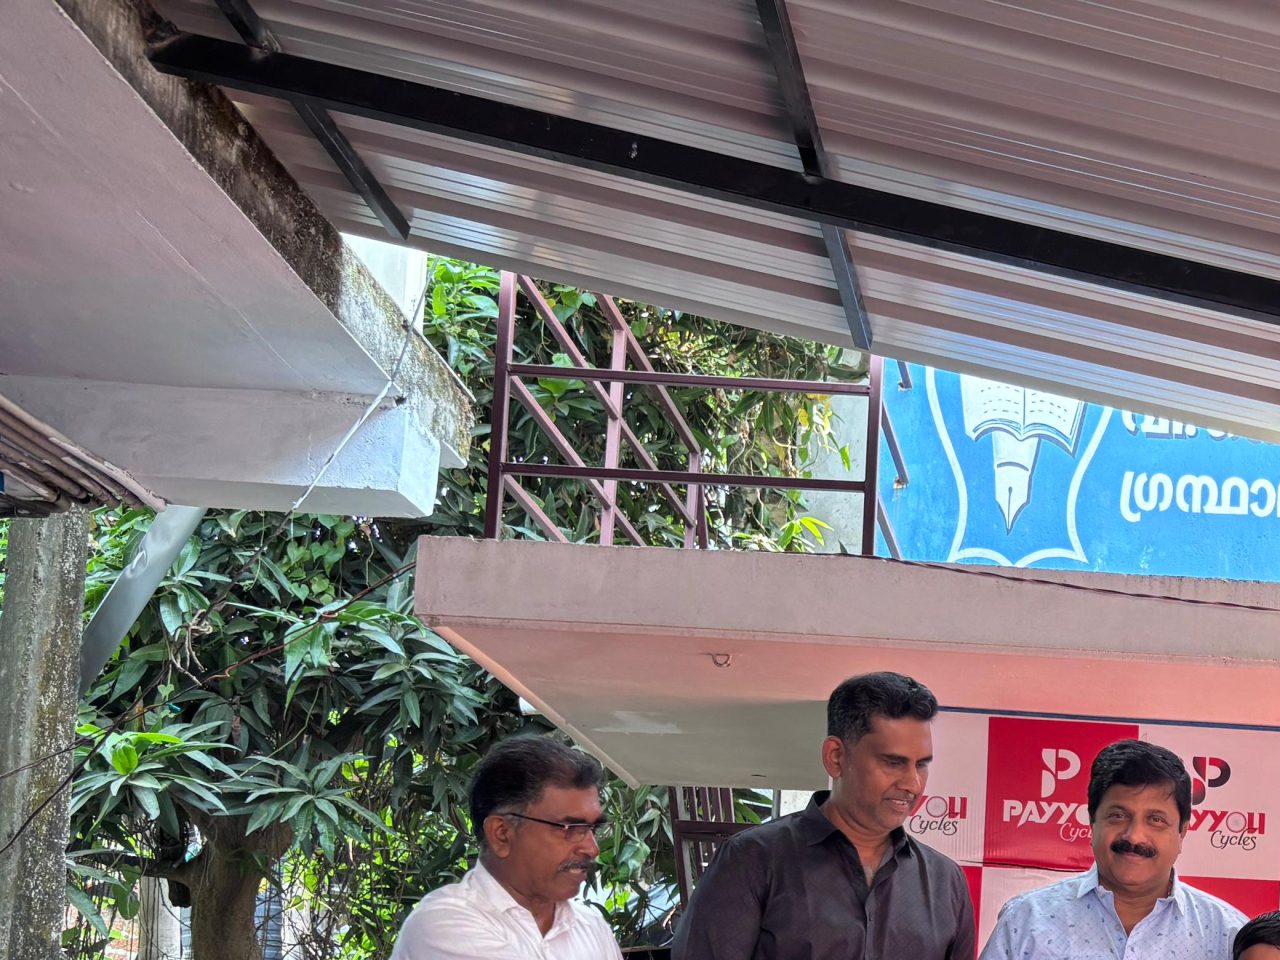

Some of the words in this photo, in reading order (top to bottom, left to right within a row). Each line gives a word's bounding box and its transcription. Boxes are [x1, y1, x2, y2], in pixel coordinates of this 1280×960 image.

[909, 811, 959, 836] Cycles
[1003, 799, 1091, 828] PAYYO
[1210, 827, 1257, 850] Cycles
